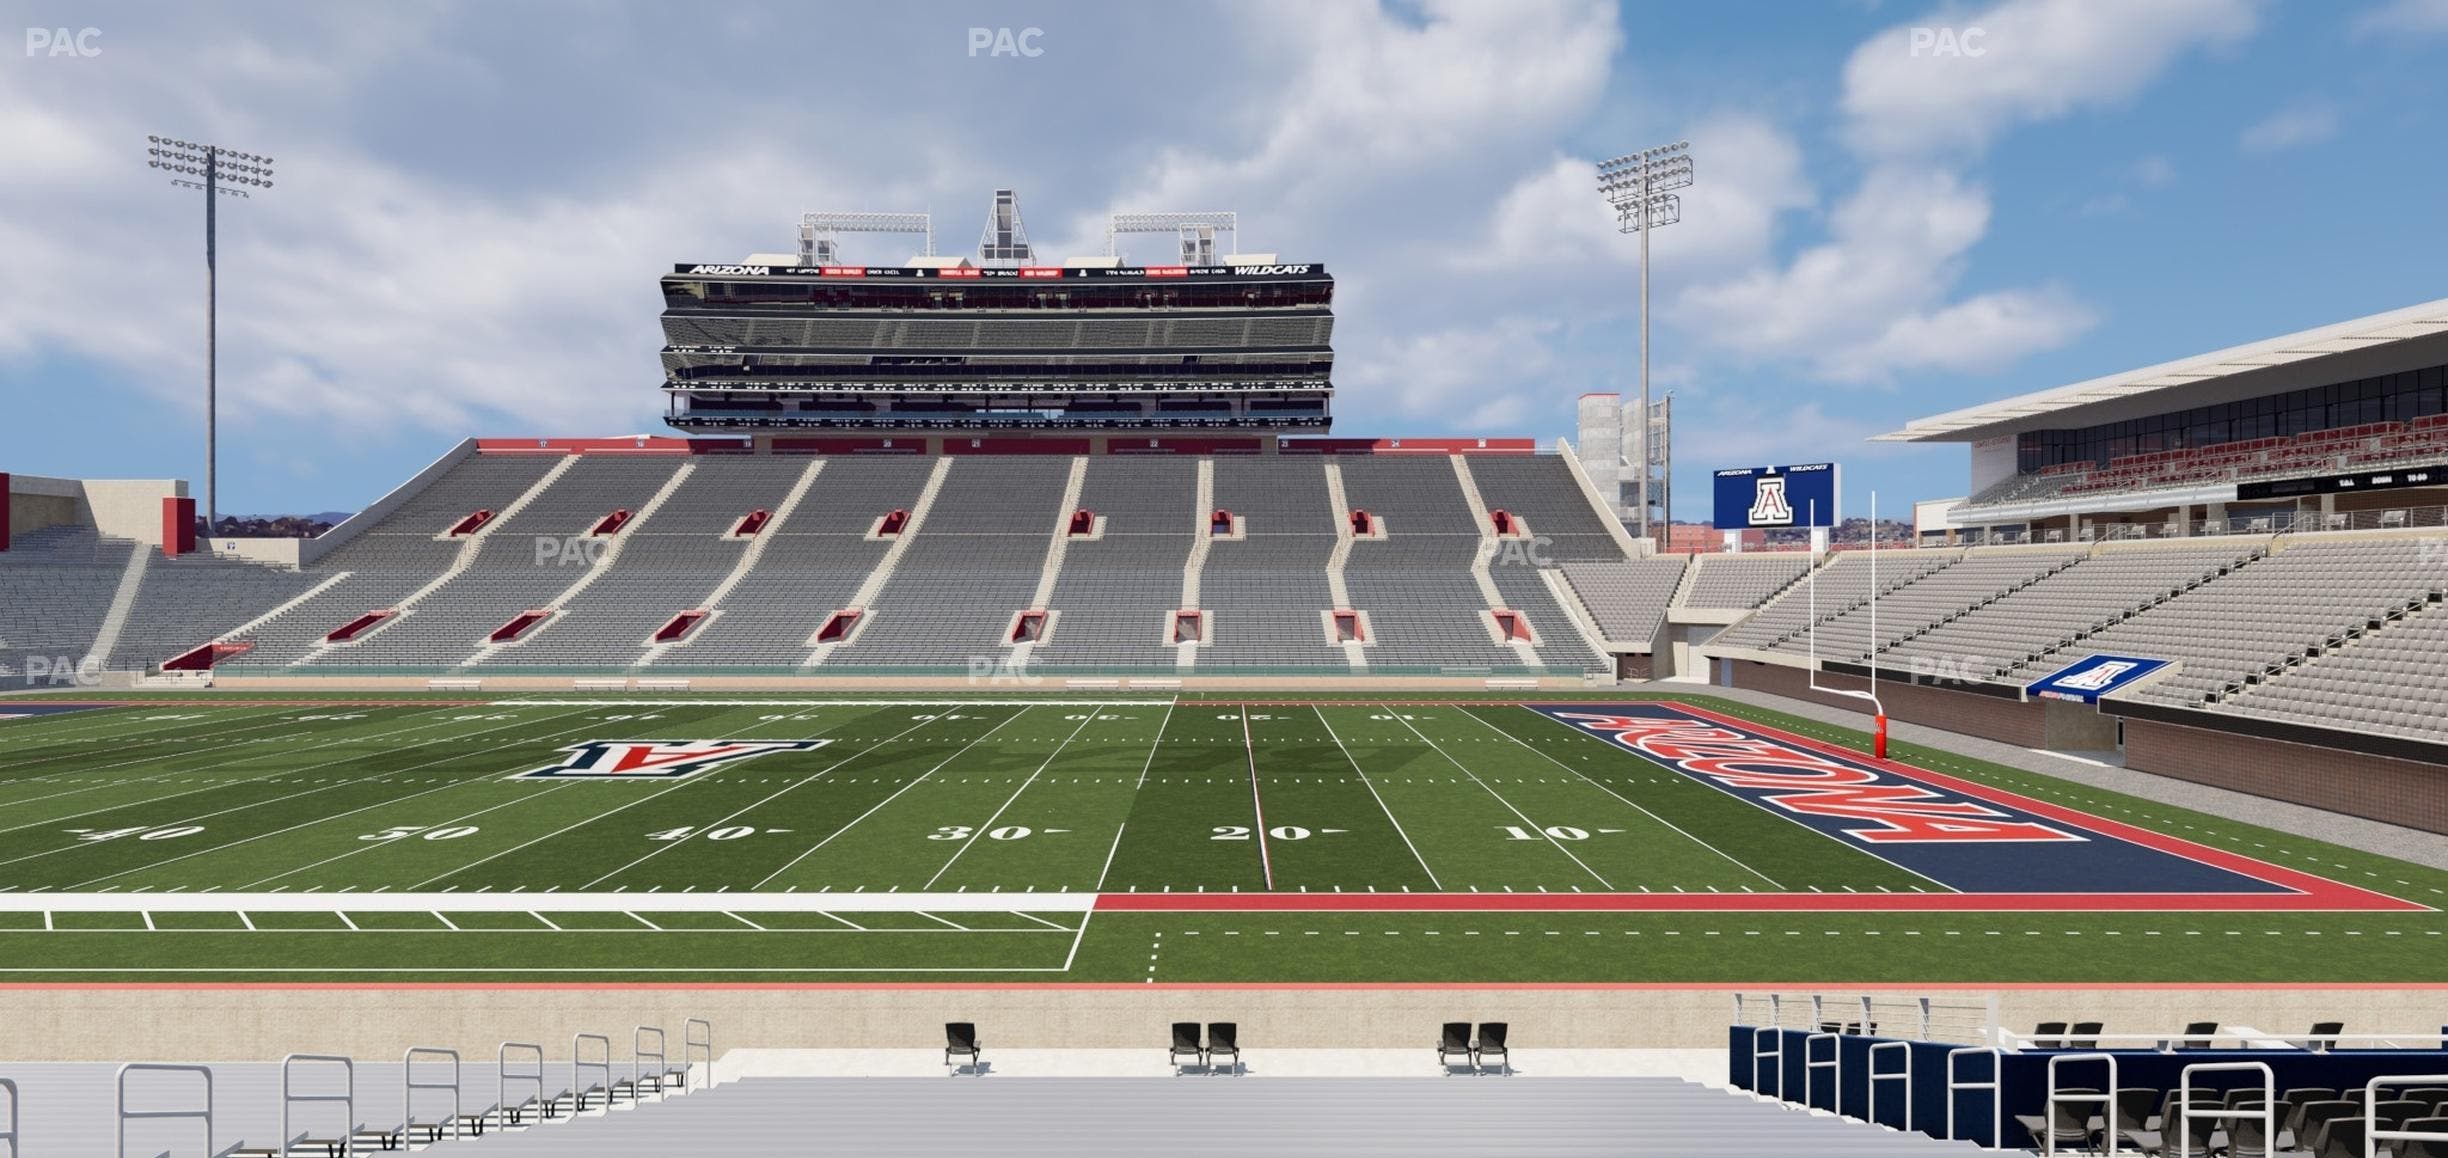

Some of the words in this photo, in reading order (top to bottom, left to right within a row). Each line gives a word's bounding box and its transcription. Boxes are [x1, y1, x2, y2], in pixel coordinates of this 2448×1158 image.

[689, 265, 770, 275] ARIZONA
[1234, 265, 1310, 275] WILDCATS
[1789, 464, 1828, 472] WILDCATS
[1749, 477, 1792, 525] A
[2052, 661, 2139, 691] A
[502, 739, 834, 779] A
[1553, 712, 2092, 842] ARIZONA
[358, 825, 479, 841] 50
[644, 825, 755, 841] 40
[927, 825, 1031, 841] 30
[1210, 825, 1310, 841] 20
[1494, 825, 1589, 841] 10
